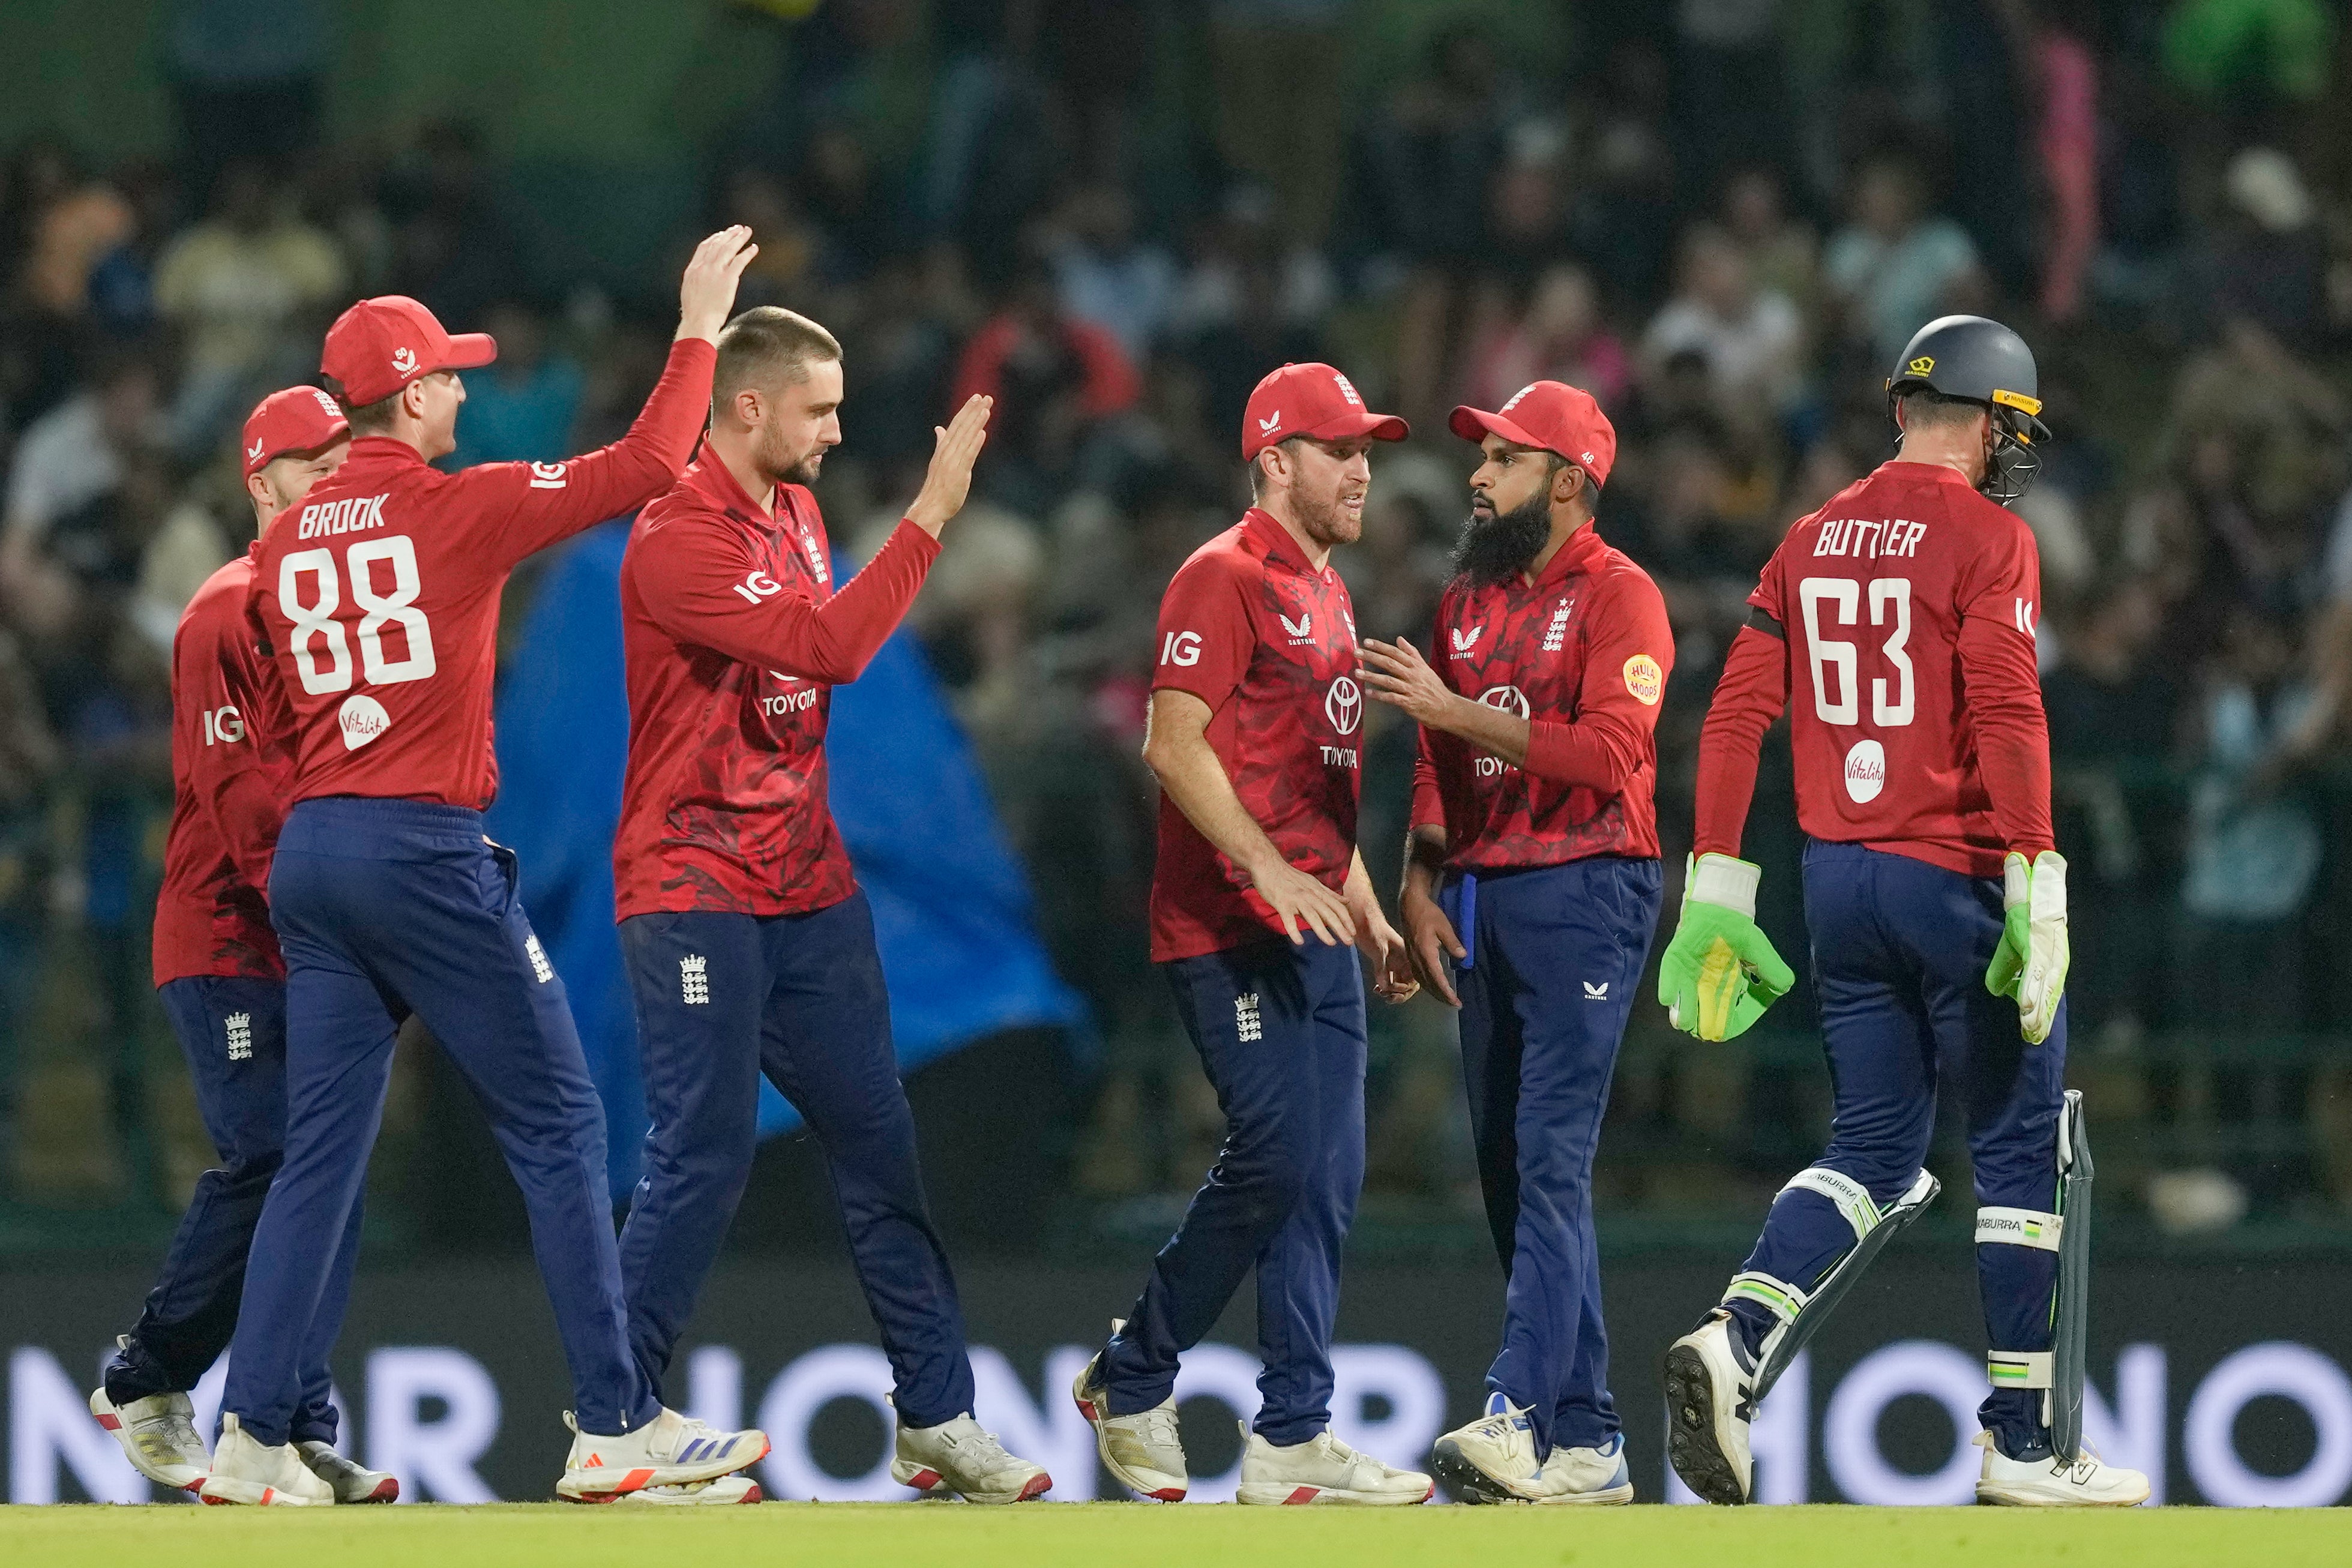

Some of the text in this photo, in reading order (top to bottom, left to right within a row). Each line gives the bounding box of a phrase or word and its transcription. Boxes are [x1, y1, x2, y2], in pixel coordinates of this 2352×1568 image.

[394, 346, 408, 360] 50
[2011, 395, 2035, 407] MASURI
[1581, 451, 1595, 464] 46
[530, 459, 567, 489] IG
[298, 493, 390, 540] BROOK
[1812, 518, 1928, 559] BUTTLER
[733, 569, 782, 604] IG
[278, 535, 436, 695] 88
[1160, 631, 1202, 667] IG
[1449, 652, 1475, 660] CASTORE
[1799, 577, 1915, 727] 63
[1631, 664, 1655, 679] HULA
[762, 687, 816, 716] TOYOTA
[1630, 680, 1657, 697] HOOPS
[204, 705, 245, 746] IG
[1320, 745, 1358, 769] TOYOTA
[1474, 757, 1518, 777] TOY
[1847, 755, 1883, 789] Vitality
